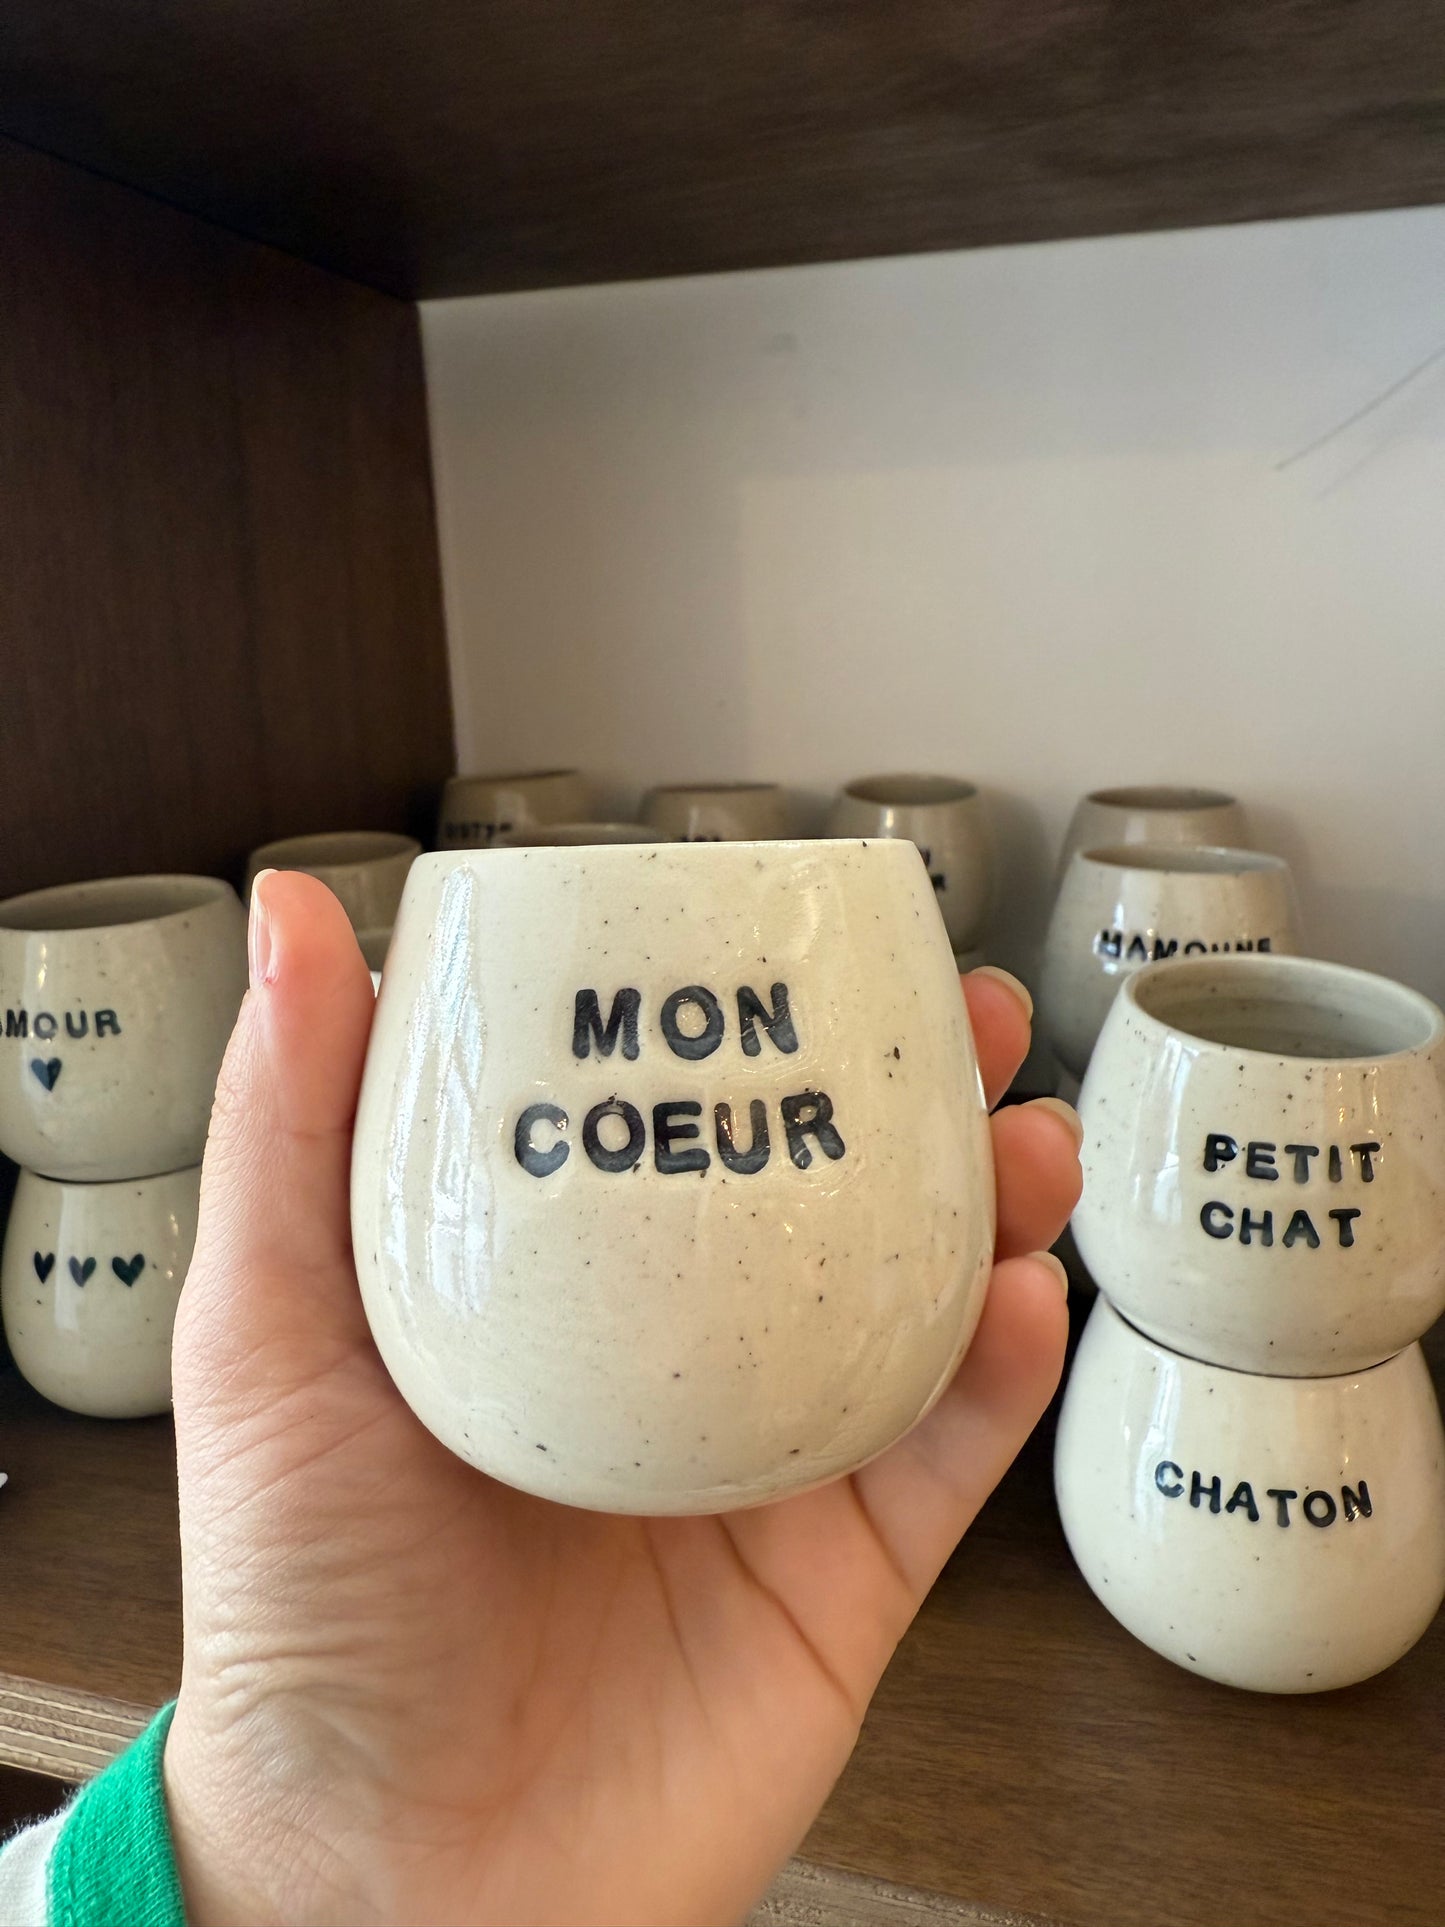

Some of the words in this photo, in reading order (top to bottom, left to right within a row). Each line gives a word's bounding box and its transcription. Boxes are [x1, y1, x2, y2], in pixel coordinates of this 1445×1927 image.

[0, 1009, 121, 1039] MOUR
[572, 982, 799, 1061] MON
[514, 1091, 846, 1178] COEUR
[1203, 1133, 1380, 1184] PETIT
[1200, 1201, 1361, 1248] CHAT
[1155, 1461, 1373, 1528] CHATON
